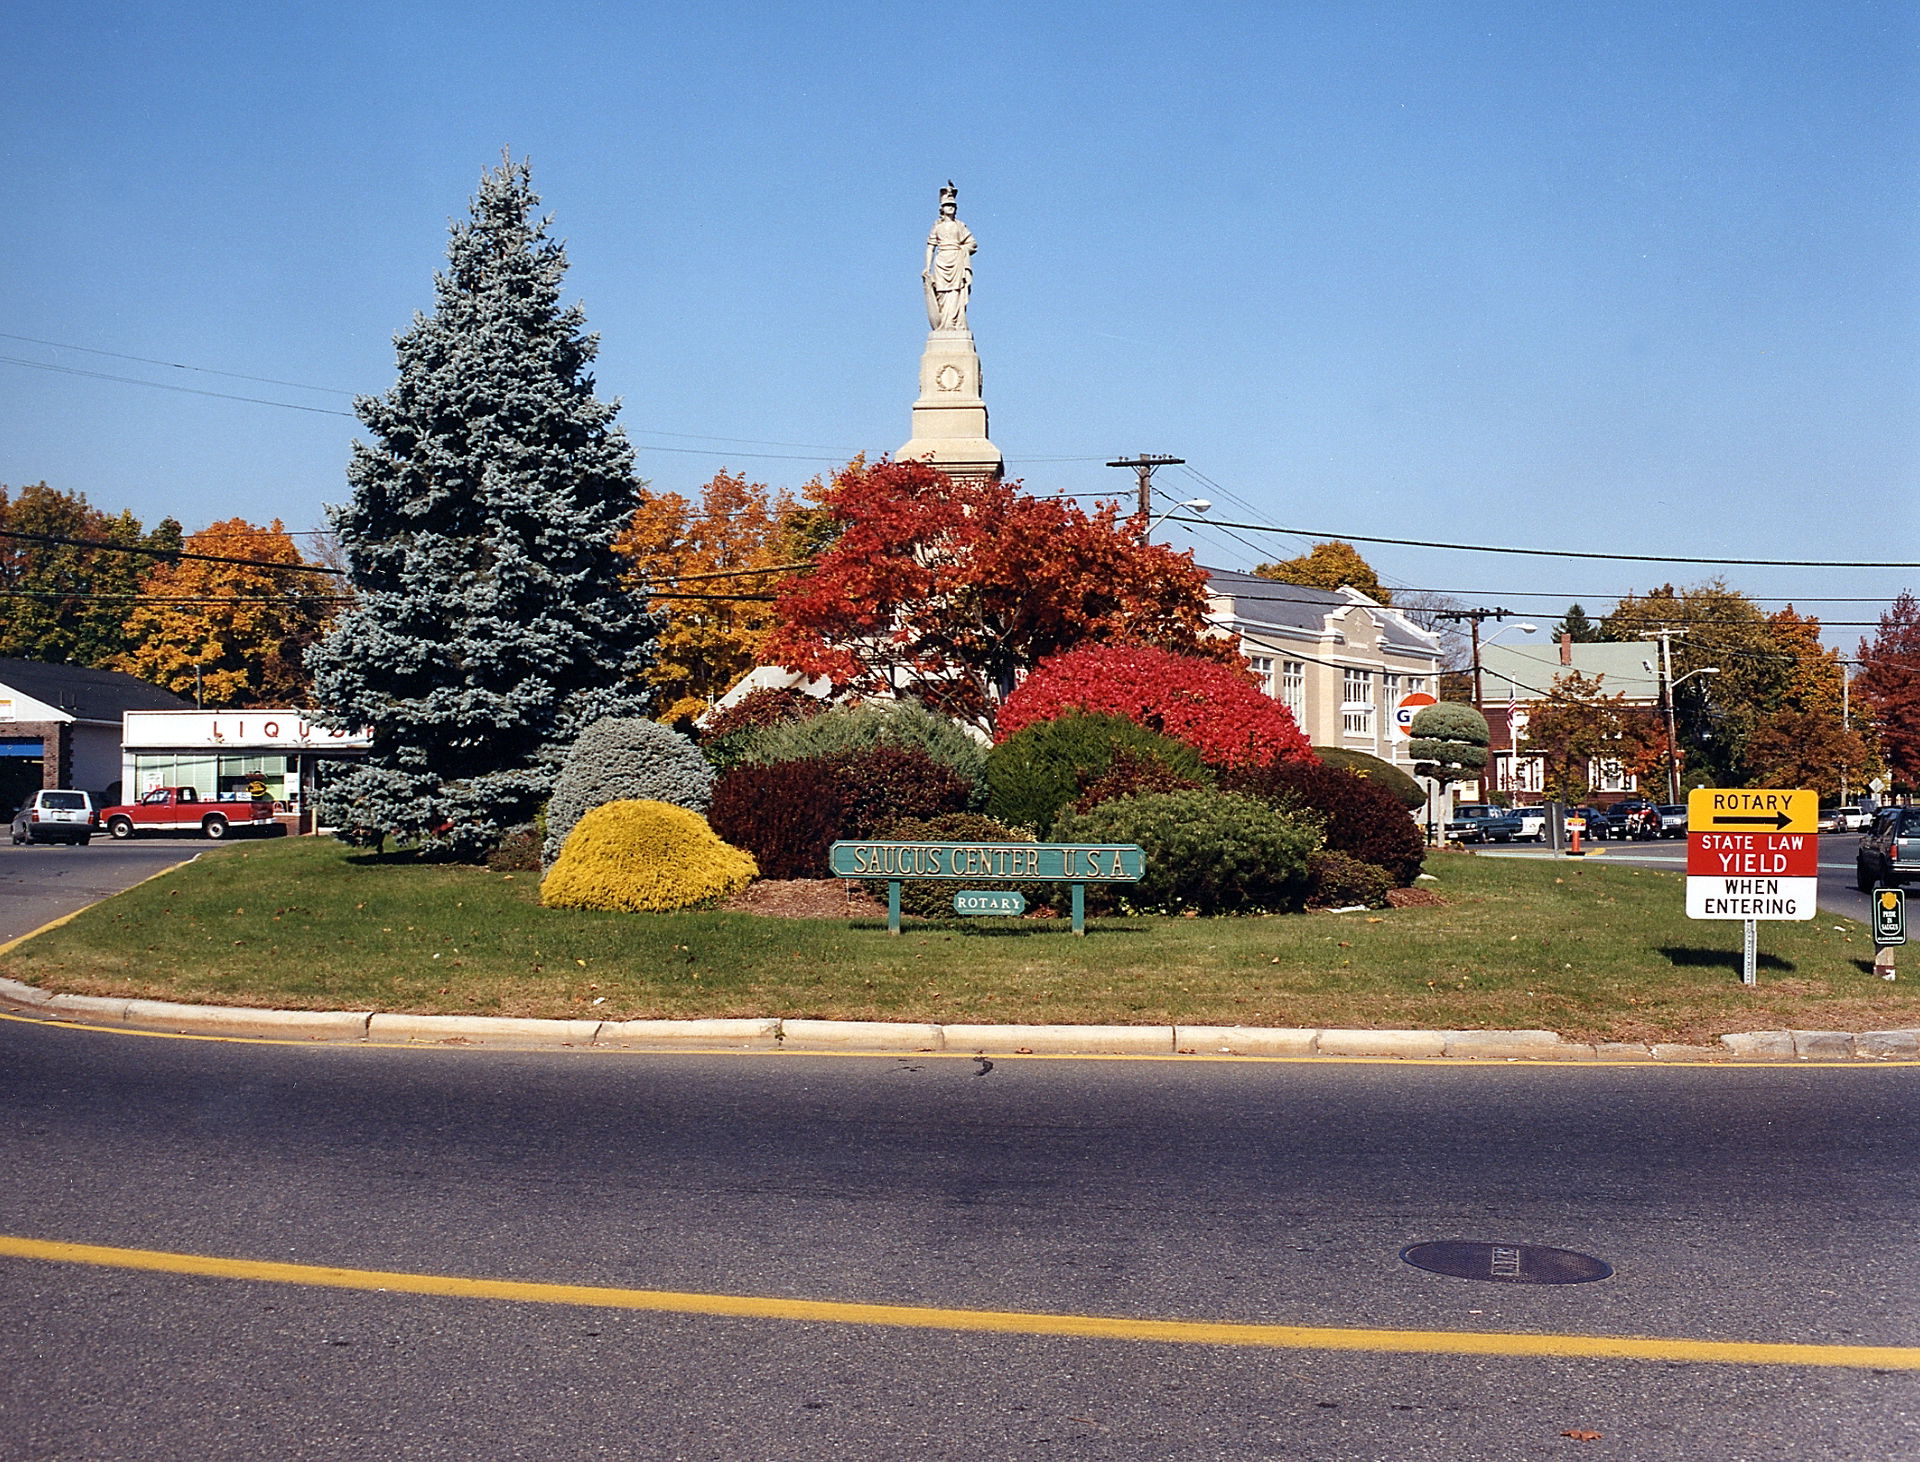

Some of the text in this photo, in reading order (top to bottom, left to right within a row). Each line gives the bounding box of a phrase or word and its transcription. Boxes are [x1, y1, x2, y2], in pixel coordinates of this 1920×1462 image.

[1713, 794, 1793, 810] ROTARY
[1701, 834, 1804, 850] STATE LAW
[951, 848, 1039, 876] CENTER
[1718, 853, 1787, 873] YIELD
[1725, 879, 1778, 895] WHEN
[957, 897, 1020, 910] ROTARY
[1705, 898, 1796, 915] ENTERING
